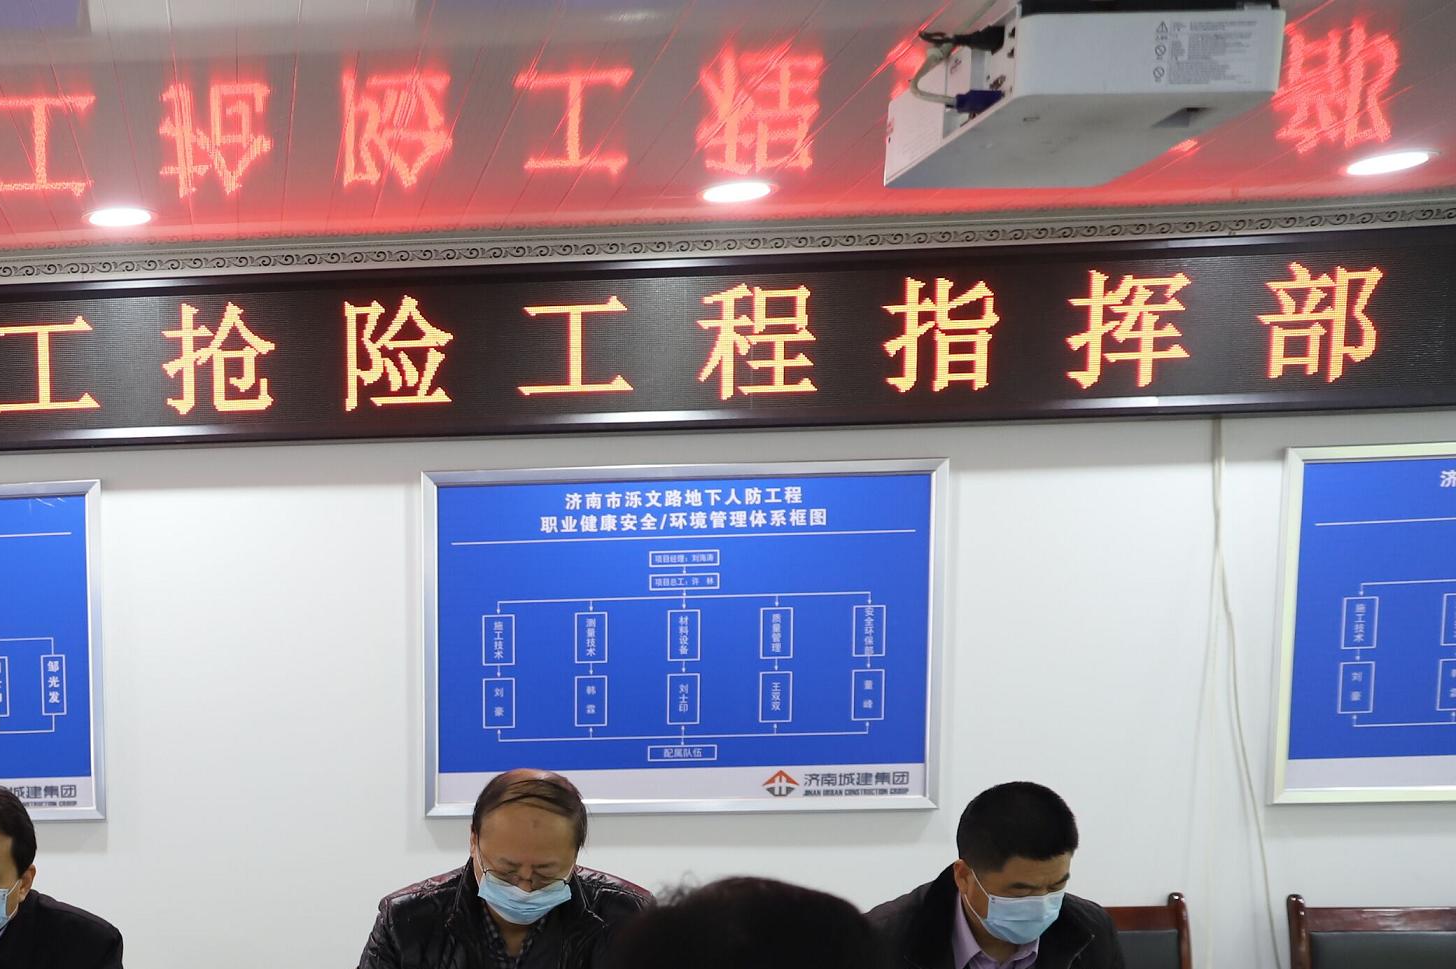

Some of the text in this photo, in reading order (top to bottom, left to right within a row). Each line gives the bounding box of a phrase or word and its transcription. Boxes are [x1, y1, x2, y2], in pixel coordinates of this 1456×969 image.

[564, 486, 803, 512] 济南市泺文路地下人防工程
[540, 508, 828, 534] 职业健康安全/环境管理体系框图
[678, 615, 689, 655] 材料设备
[803, 770, 910, 787] 济南城建集团
